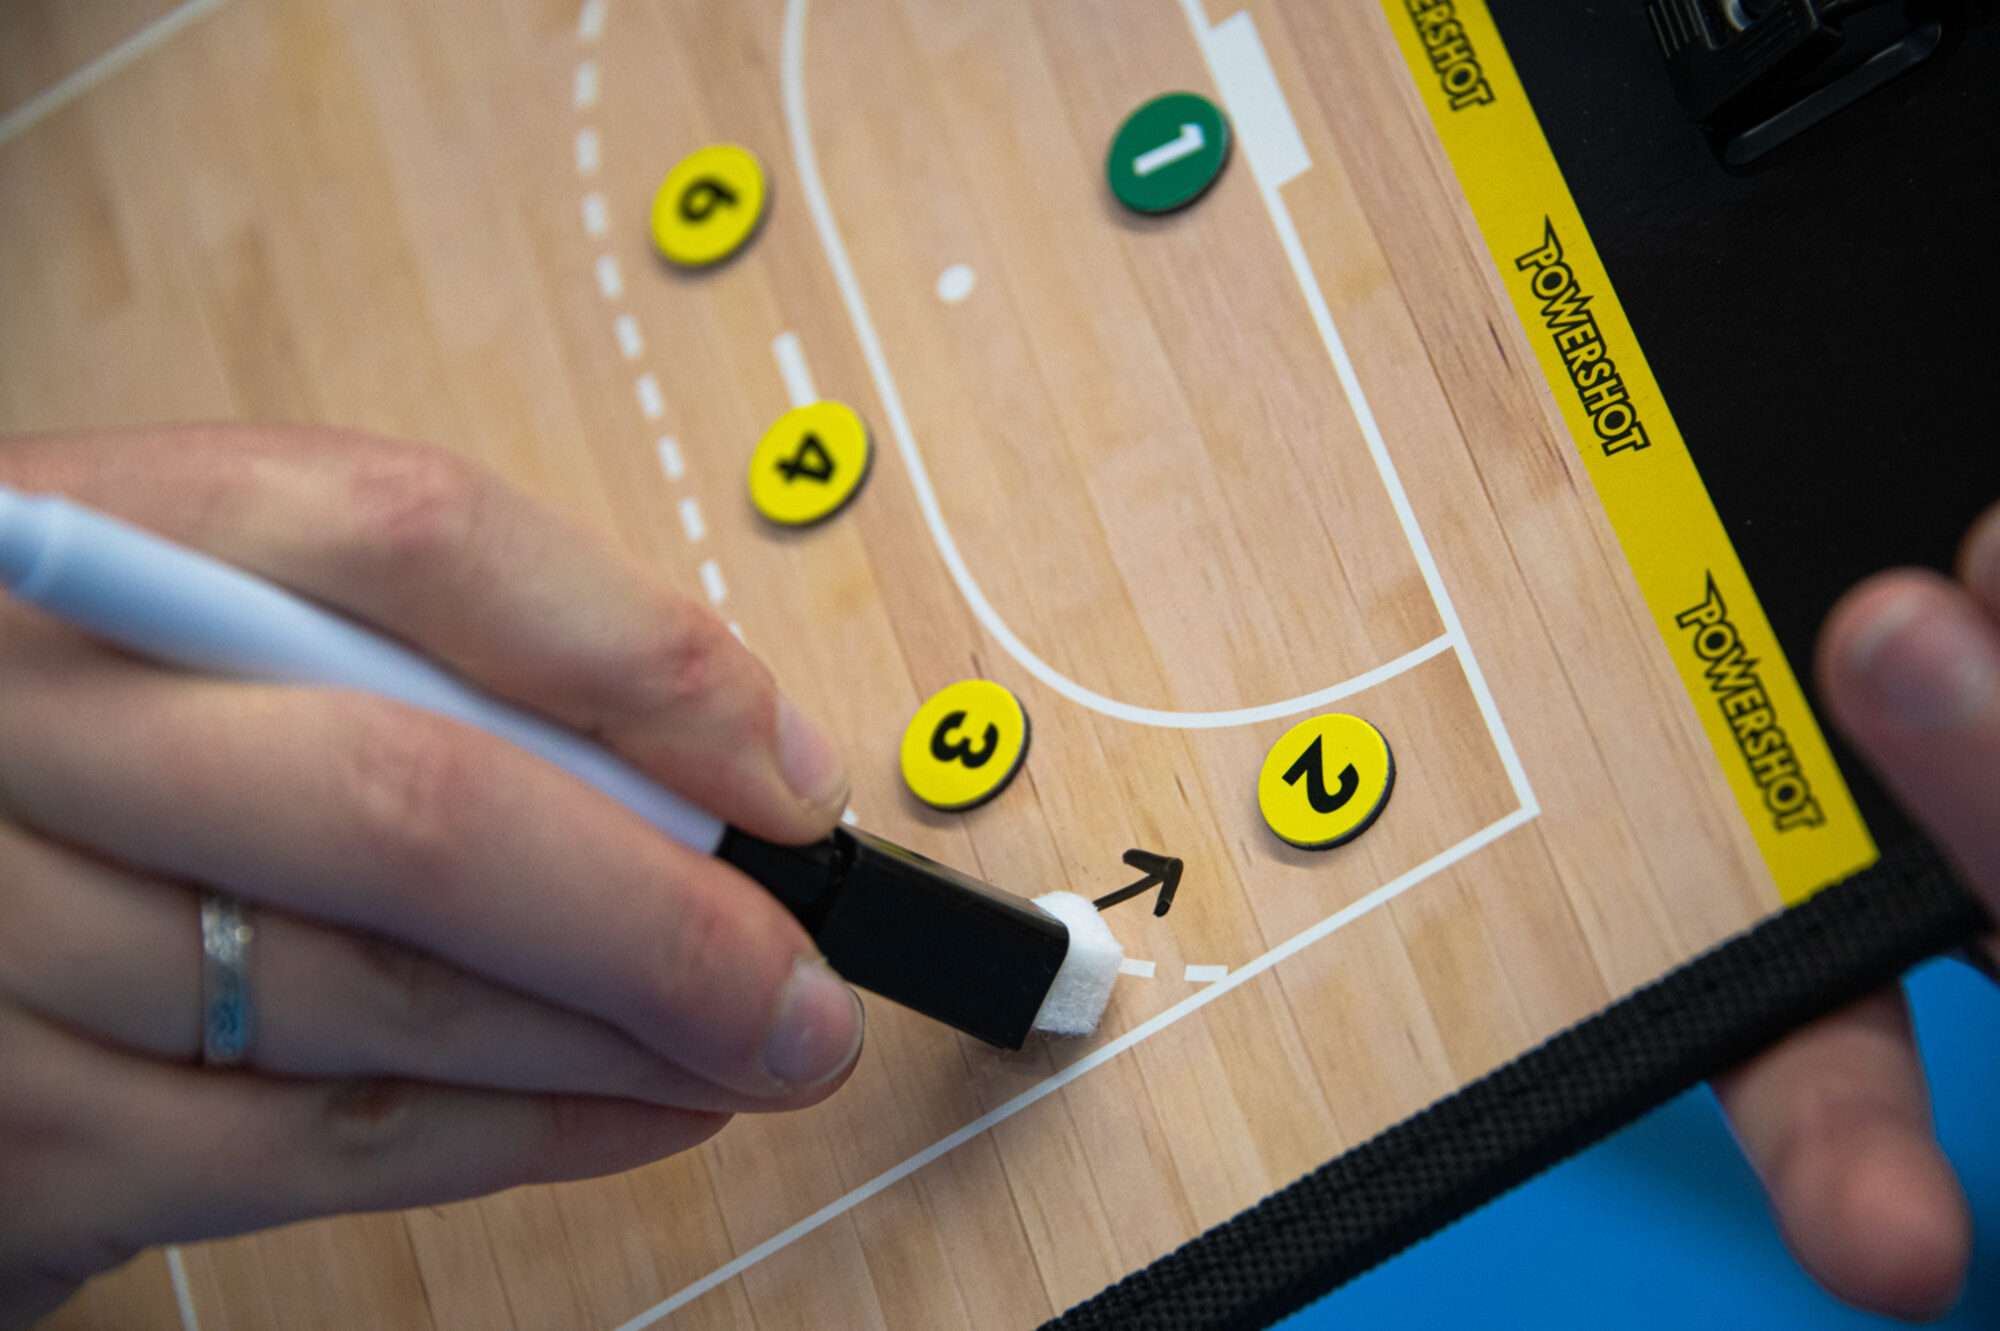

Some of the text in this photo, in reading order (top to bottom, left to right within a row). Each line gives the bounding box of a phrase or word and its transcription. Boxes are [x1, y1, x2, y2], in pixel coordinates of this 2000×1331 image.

[1133, 122, 1205, 176] 1
[679, 176, 738, 224] 6
[1515, 214, 1651, 456] POWERSHOT
[775, 432, 836, 484] 4
[1674, 568, 1827, 833] POWERSHOT
[930, 709, 999, 769] 3
[1281, 734, 1360, 814] 2
